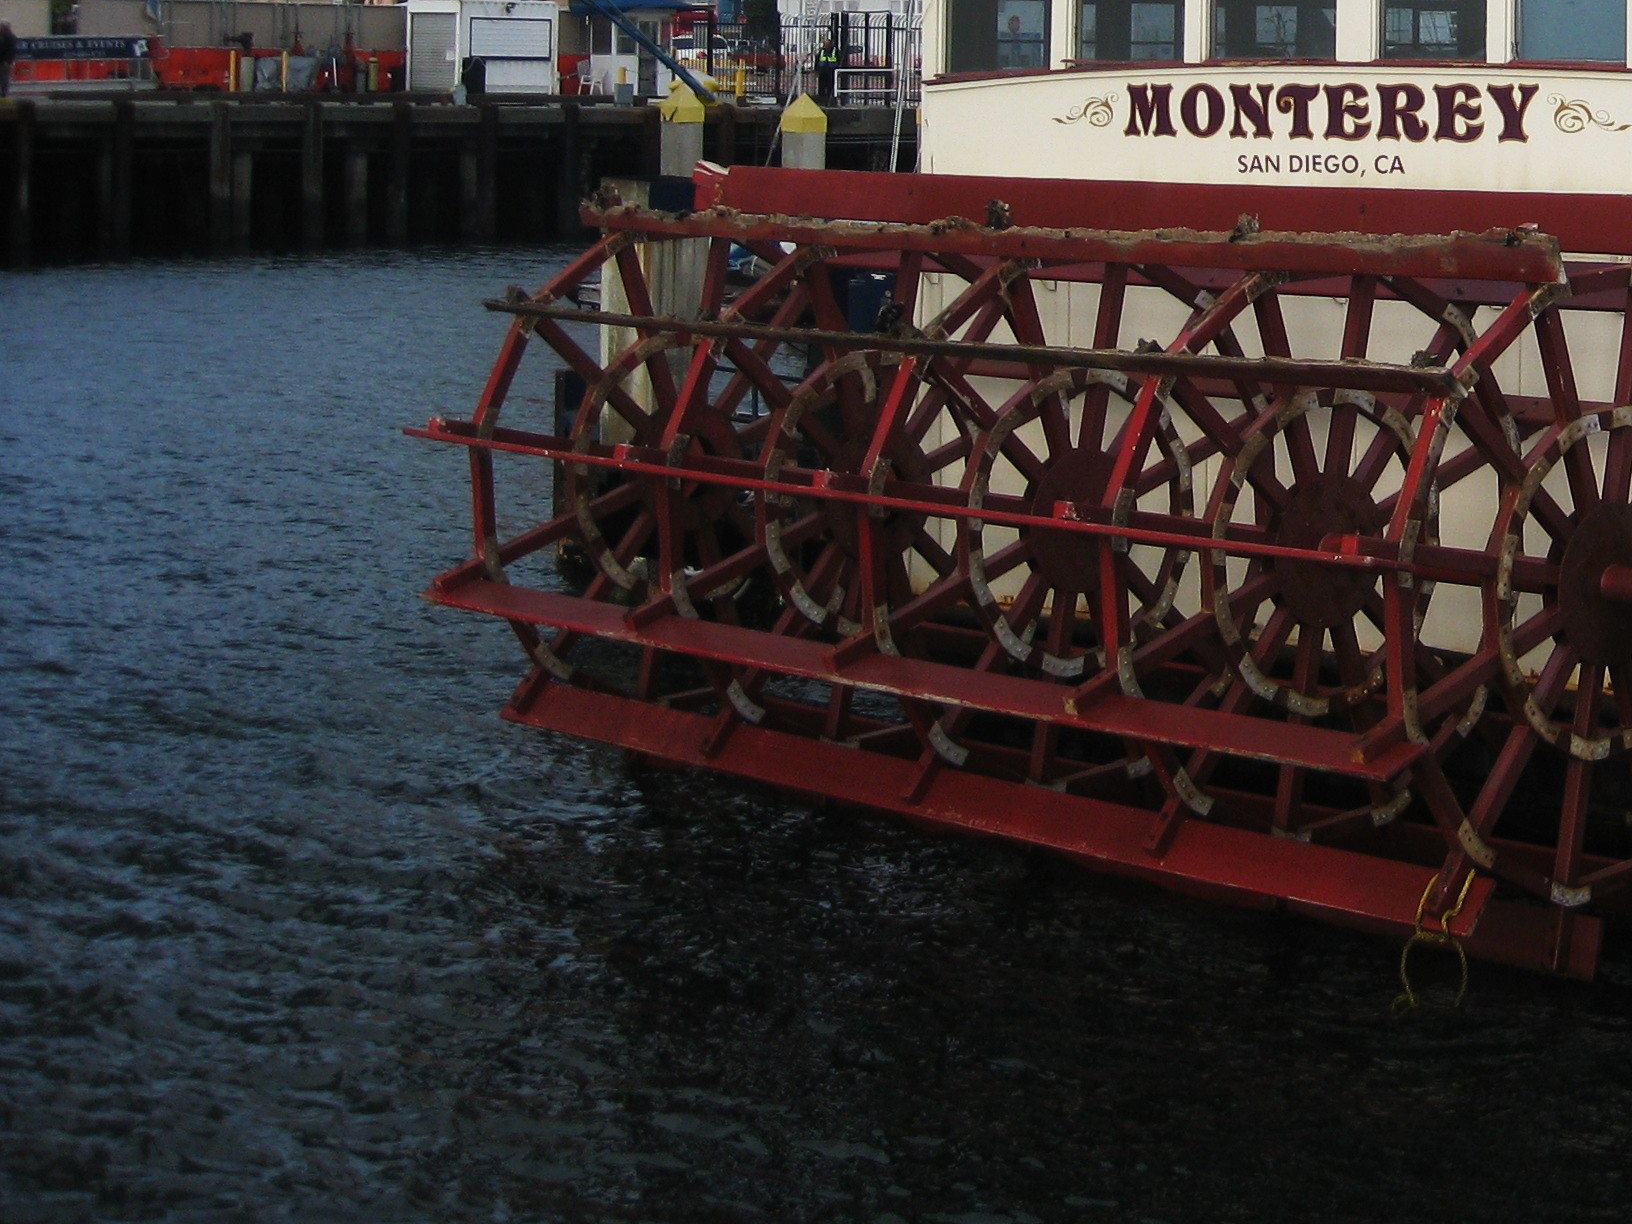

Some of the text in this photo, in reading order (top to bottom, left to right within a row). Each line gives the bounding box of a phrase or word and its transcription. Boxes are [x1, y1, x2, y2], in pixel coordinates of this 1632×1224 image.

[31, 39, 73, 50] CRUISES
[75, 40, 84, 49] &
[87, 39, 127, 49] EVENTS
[1123, 81, 1540, 144] MONTEREY
[1237, 154, 1406, 178] SAN DIEGO, CA
